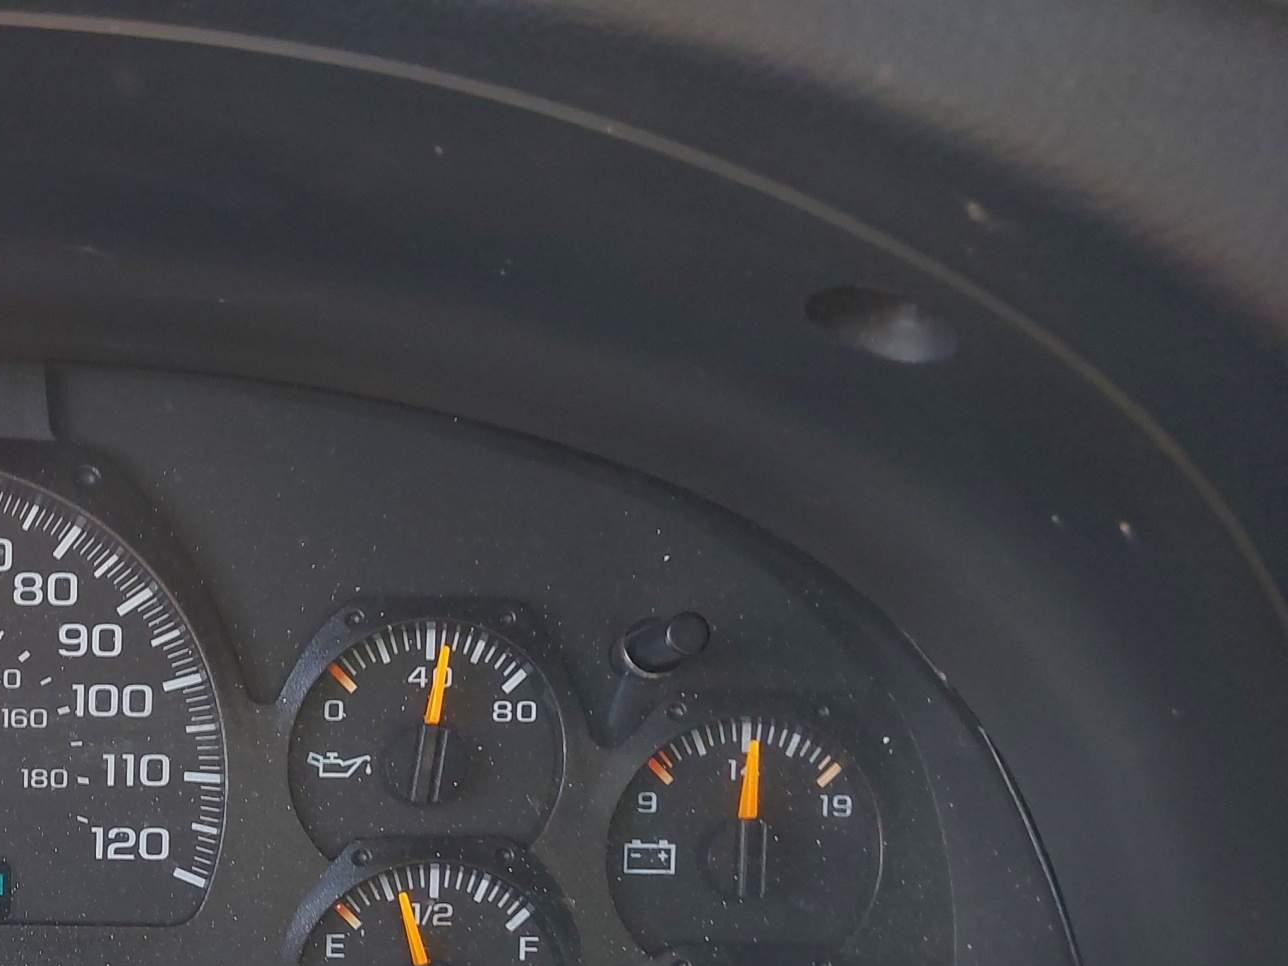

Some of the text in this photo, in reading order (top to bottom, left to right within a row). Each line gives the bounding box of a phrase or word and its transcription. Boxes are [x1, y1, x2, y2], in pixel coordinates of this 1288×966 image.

[13, 572, 78, 606] 80
[58, 623, 123, 657] 90
[407, 666, 453, 689] 40
[71, 684, 153, 718] 100
[324, 699, 344, 722] 0
[492, 700, 537, 723] 80
[1, 708, 48, 729] 160
[21, 767, 68, 789] 180
[102, 753, 171, 787] 110
[728, 758, 760, 781] 1
[637, 791, 658, 813] 9
[819, 794, 853, 817] 19
[91, 826, 170, 860] 120
[411, 902, 453, 926] 1/2
[325, 933, 345, 959] E
[519, 936, 540, 961] F
